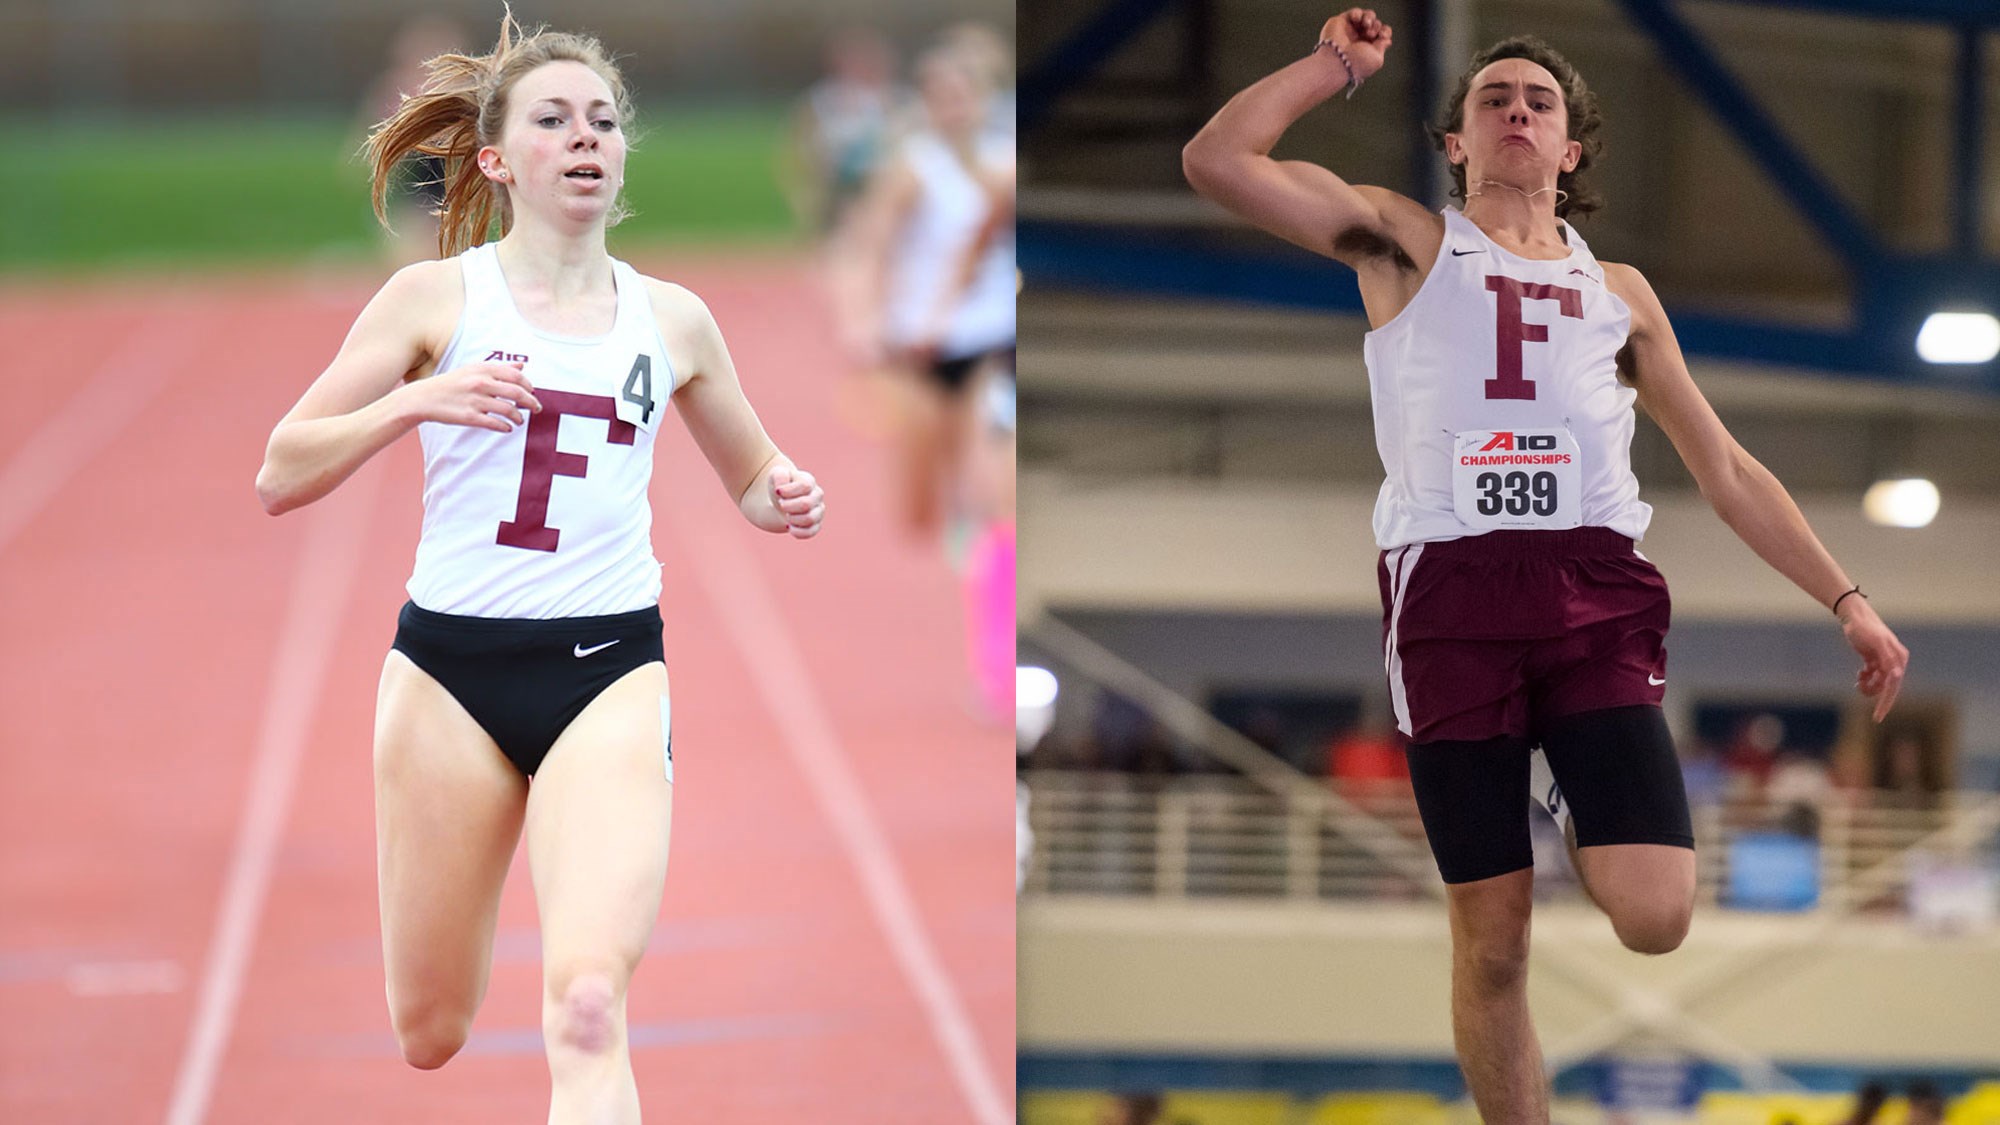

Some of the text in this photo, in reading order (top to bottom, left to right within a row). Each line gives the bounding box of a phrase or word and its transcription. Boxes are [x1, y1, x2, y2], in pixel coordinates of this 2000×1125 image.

[1485, 275, 1584, 400] F
[622, 353, 655, 424] 4
[496, 387, 636, 553] F
[1460, 454, 1571, 466] CHAMPIONSHIPS
[1478, 432, 1556, 452] A10
[1476, 471, 1557, 516] 339
